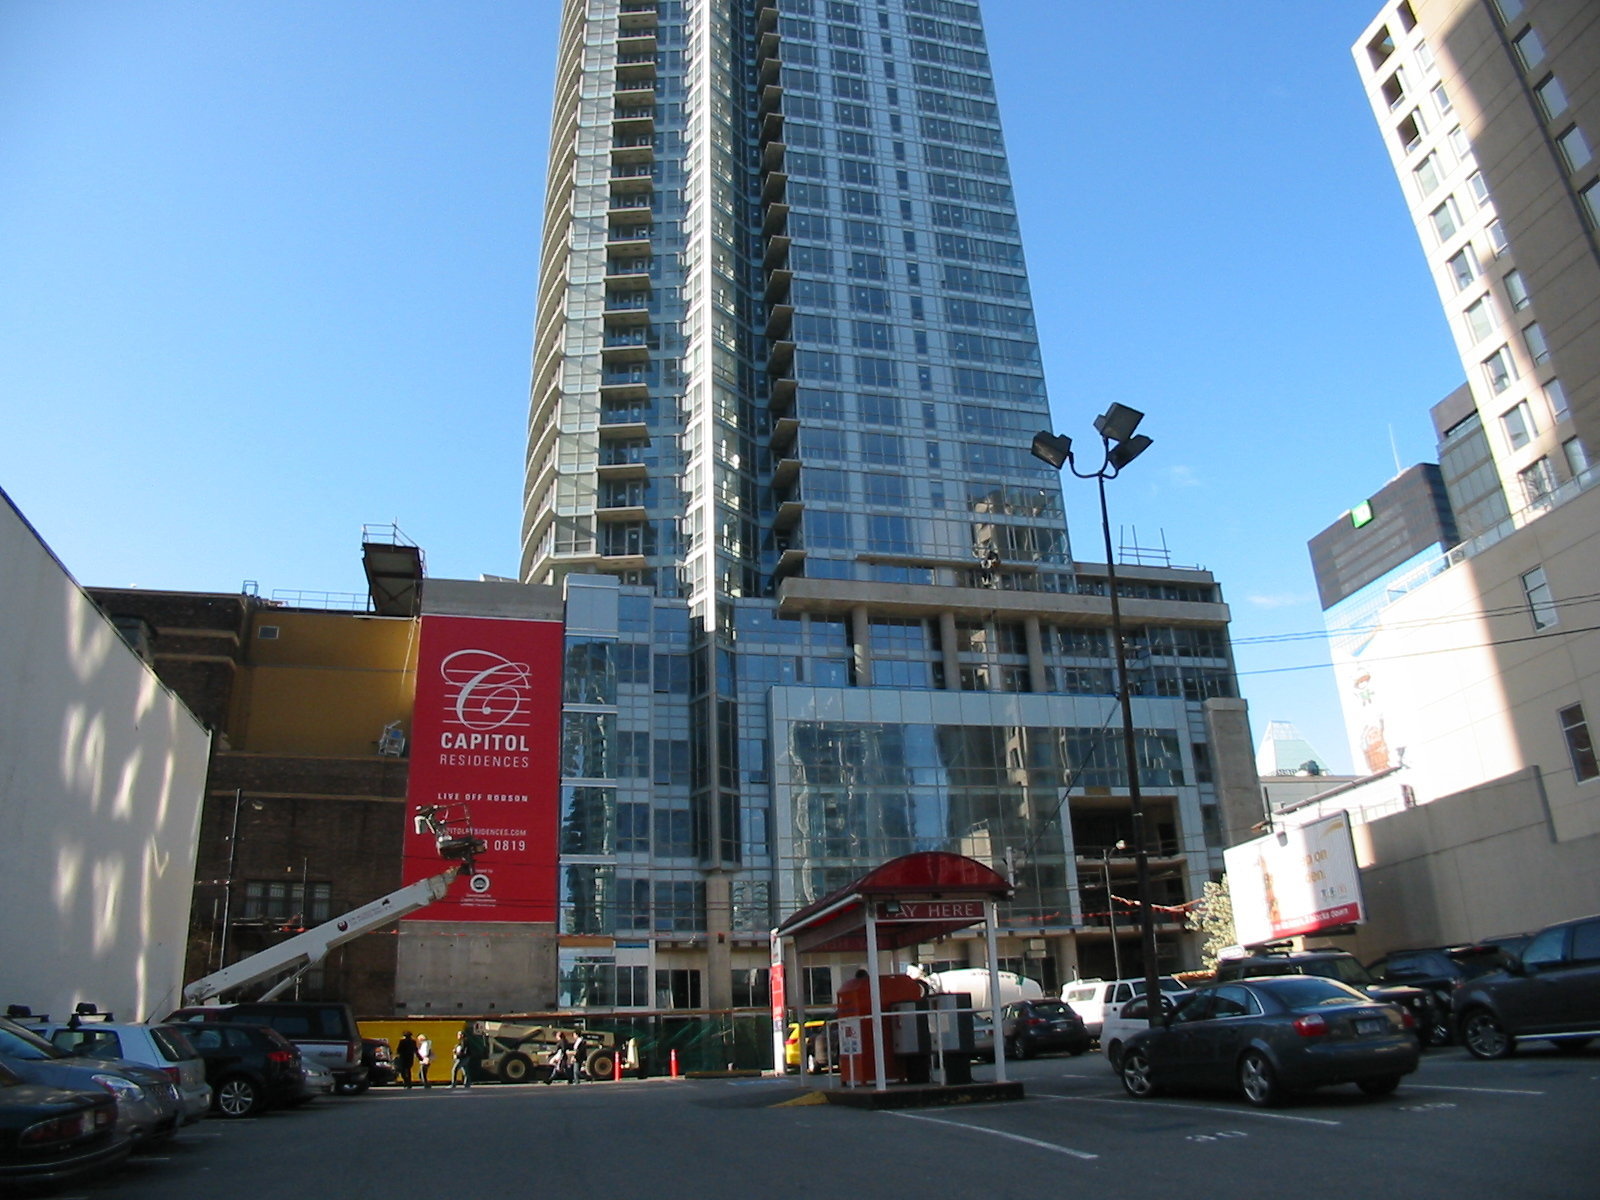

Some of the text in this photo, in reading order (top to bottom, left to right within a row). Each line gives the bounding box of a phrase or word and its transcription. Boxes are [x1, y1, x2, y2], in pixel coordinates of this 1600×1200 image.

[440, 732, 530, 752] CAPITOL
[439, 754, 529, 768] RESIDENCES
[437, 792, 529, 803] LIVE OFF ROBSON
[494, 839, 526, 851] 0819
[886, 903, 975, 918] AY HERE
